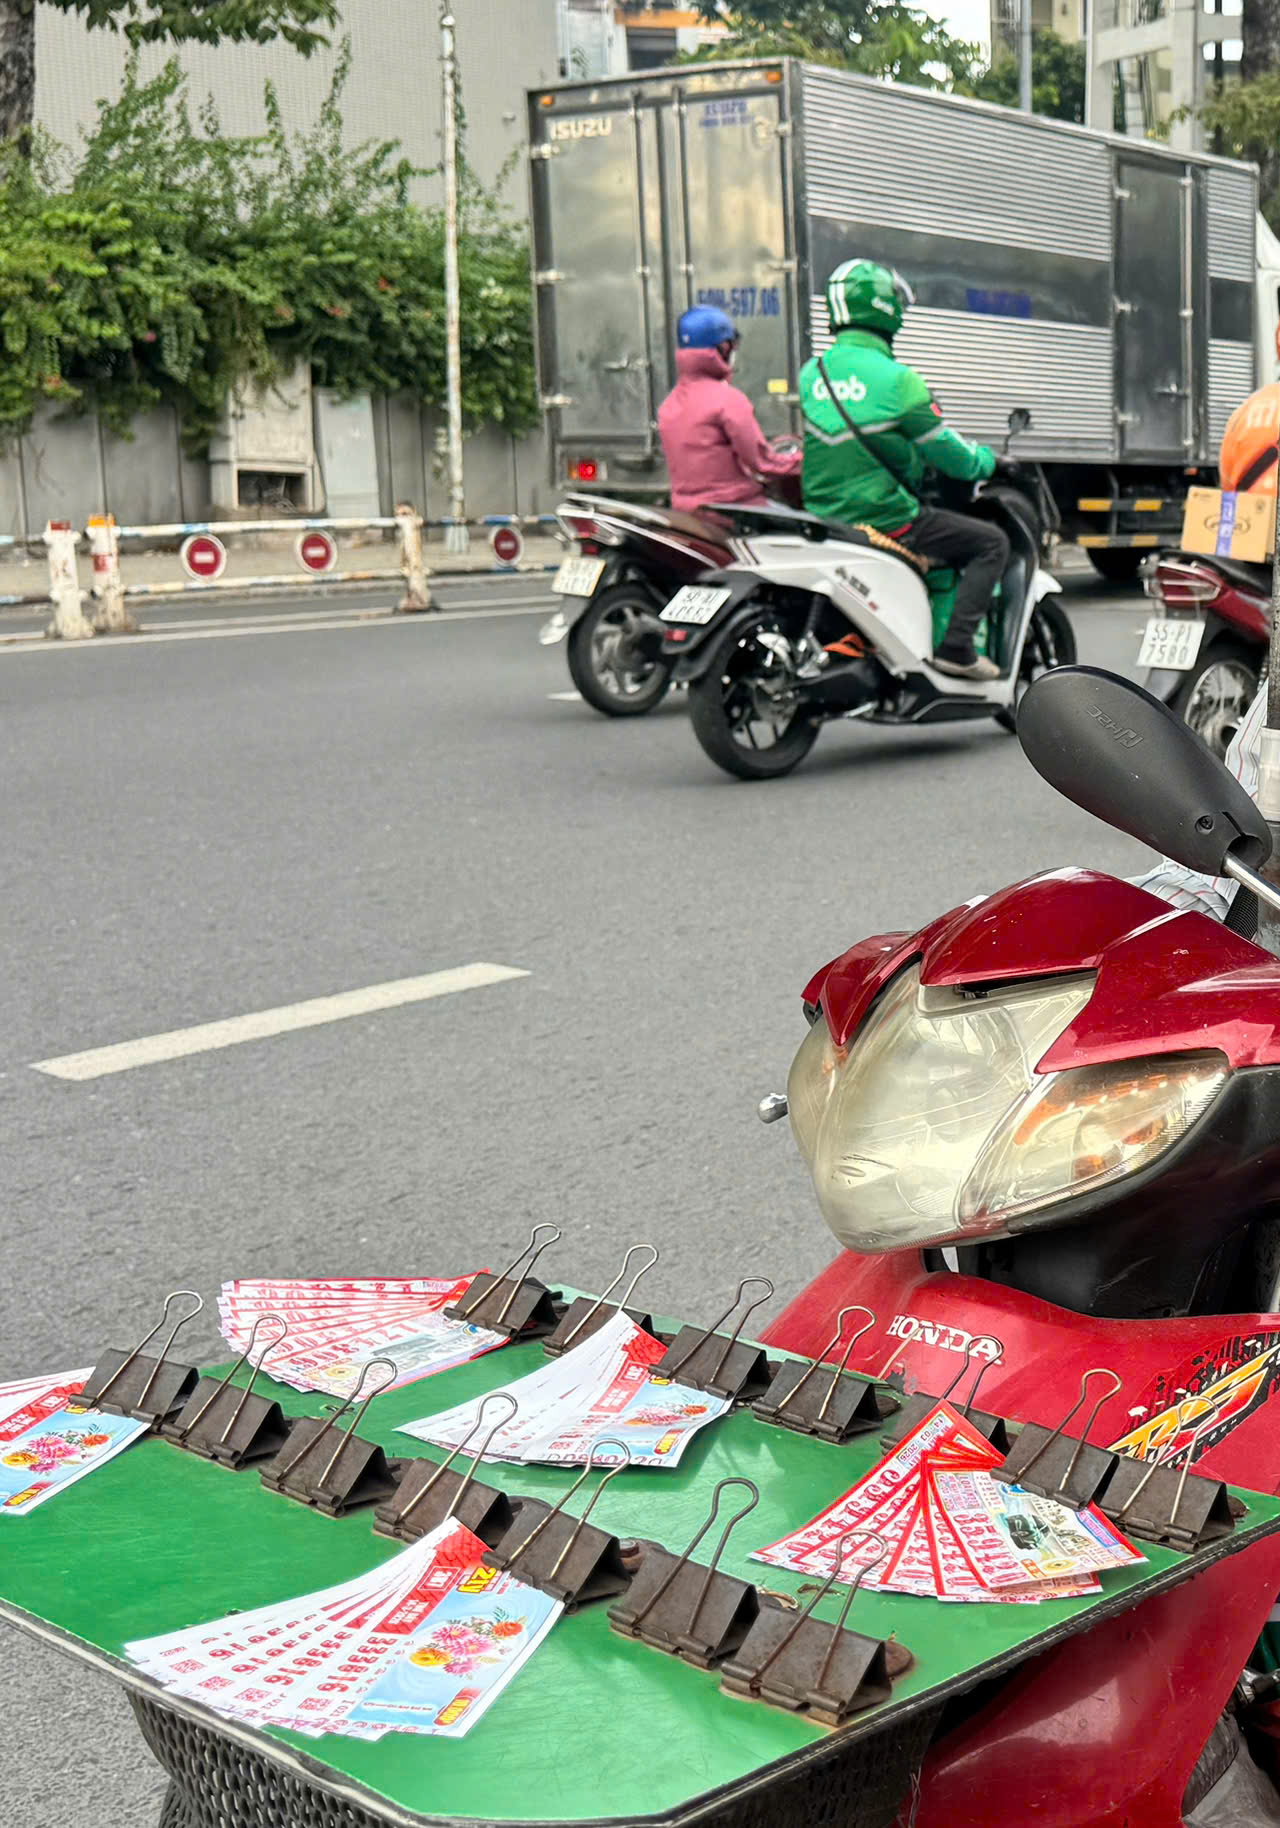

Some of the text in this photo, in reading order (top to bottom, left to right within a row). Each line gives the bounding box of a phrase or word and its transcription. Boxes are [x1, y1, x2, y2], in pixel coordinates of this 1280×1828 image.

[549, 117, 612, 139] ISUZU
[886, 1314, 1003, 1365] HONDA
[316, 1635, 398, 1693] 333816
